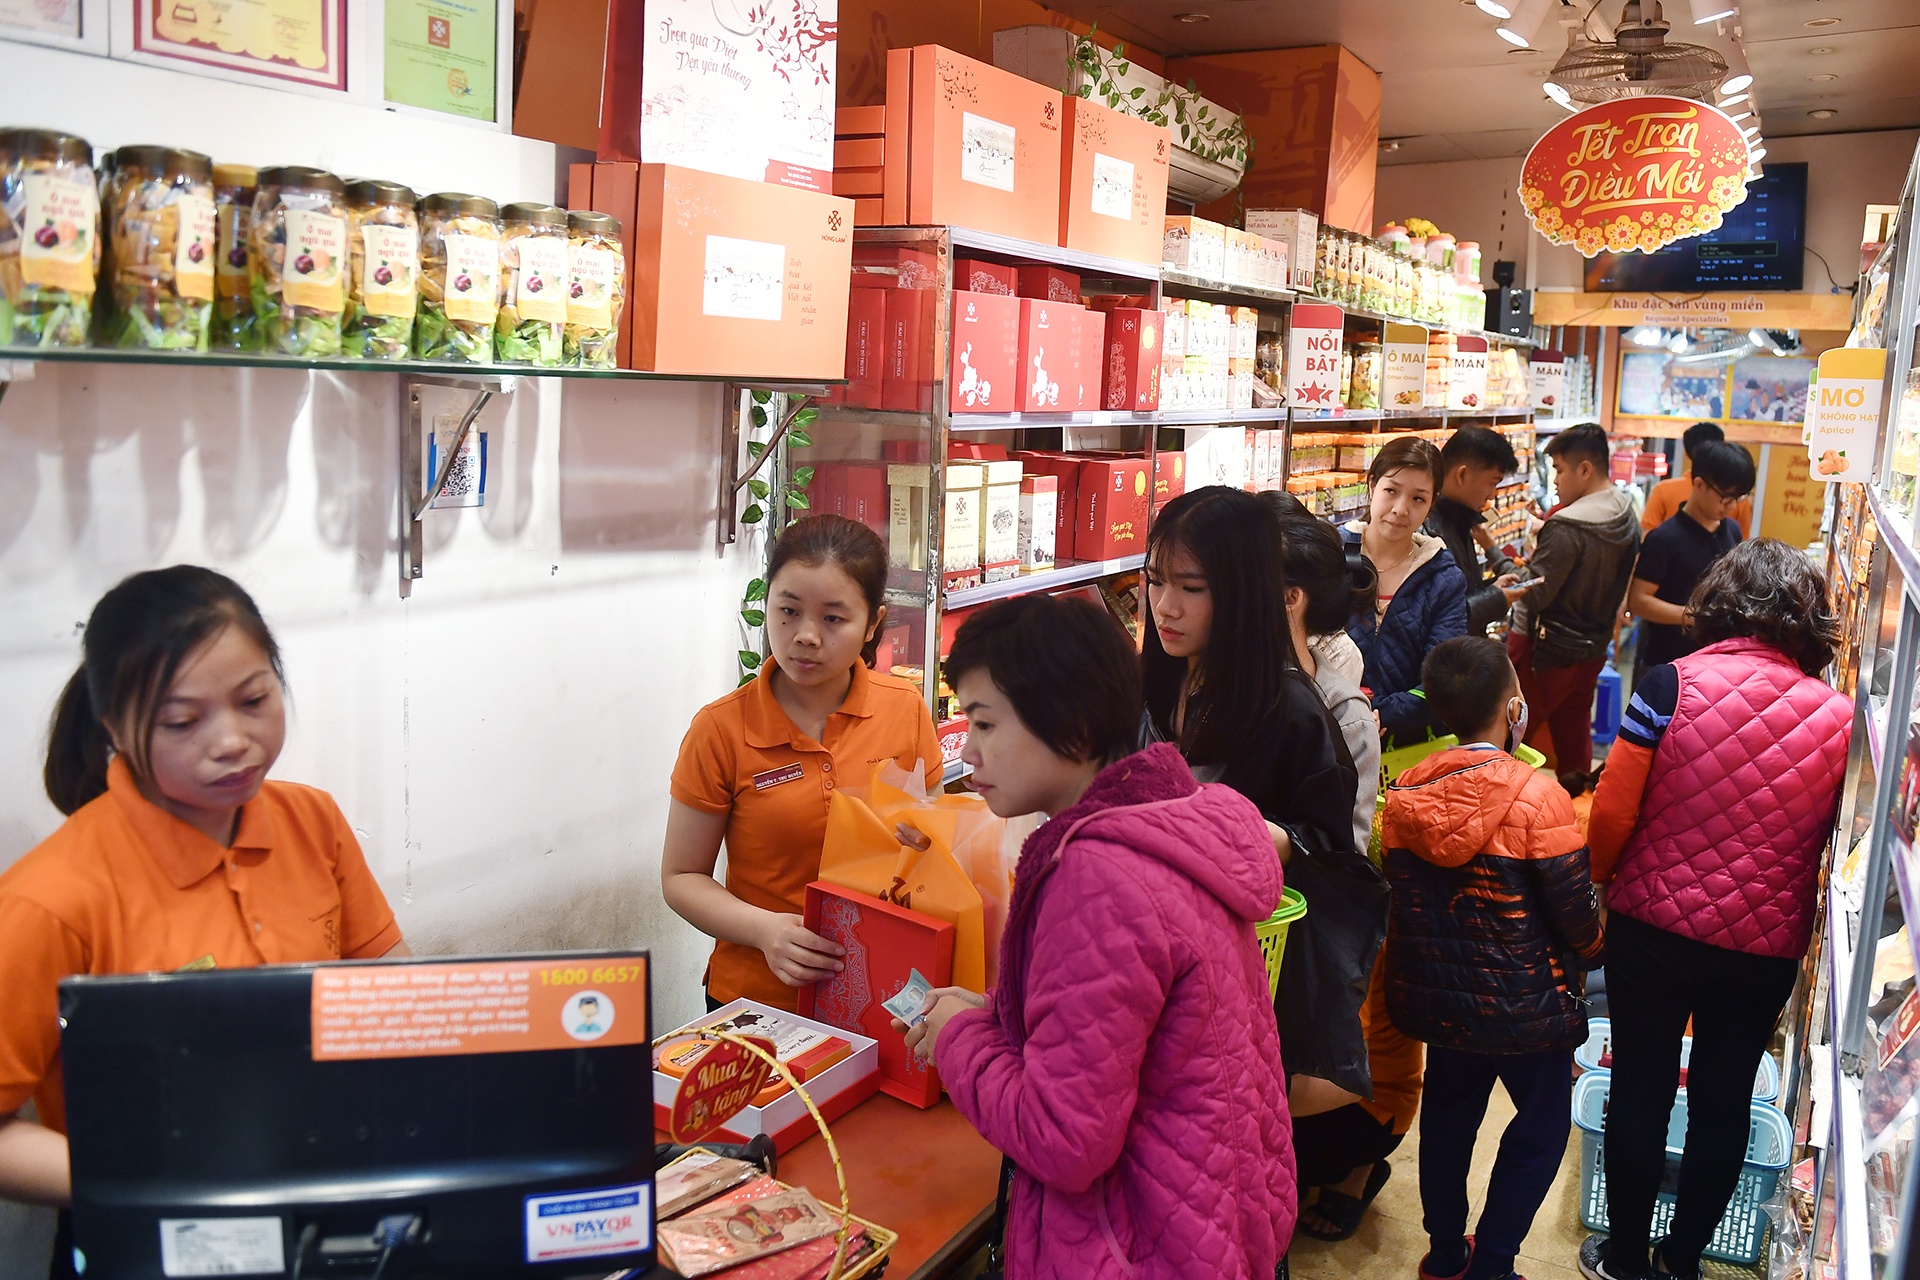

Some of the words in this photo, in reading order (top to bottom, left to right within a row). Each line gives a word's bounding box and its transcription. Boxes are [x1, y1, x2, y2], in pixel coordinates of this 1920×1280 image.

[702, 58, 718, 75] yêu
[1567, 118, 1624, 167] Tết
[1622, 106, 1701, 158] Trọn
[1636, 159, 1705, 198] Mới
[1613, 298, 1638, 310] Khu
[1642, 299, 1664, 312] đặc
[1694, 299, 1726, 313] vùng
[1730, 295, 1763, 311] miền
[1645, 314, 1679, 324] Regional
[1682, 314, 1728, 323] Specialities
[1307, 330, 1338, 351] NỔI
[1306, 355, 1337, 376] BẬT
[1388, 350, 1397, 362] Ô
[1401, 353, 1425, 363] MAI
[1454, 356, 1485, 371] MẬN
[1536, 366, 1562, 378] MẬN
[1821, 386, 1865, 407] MƠ
[1820, 412, 1856, 421] KHÔNG
[1860, 414, 1880, 424] HẠT
[1820, 426, 1855, 435] Apricot
[540, 968, 588, 986] 1800
[592, 966, 640, 984] 6657
[698, 1060, 739, 1092] Mua
[738, 1049, 758, 1082] 2
[712, 1082, 752, 1116] tặng
[751, 1062, 769, 1098] 1
[546, 1215, 632, 1238] VNPAYQR
